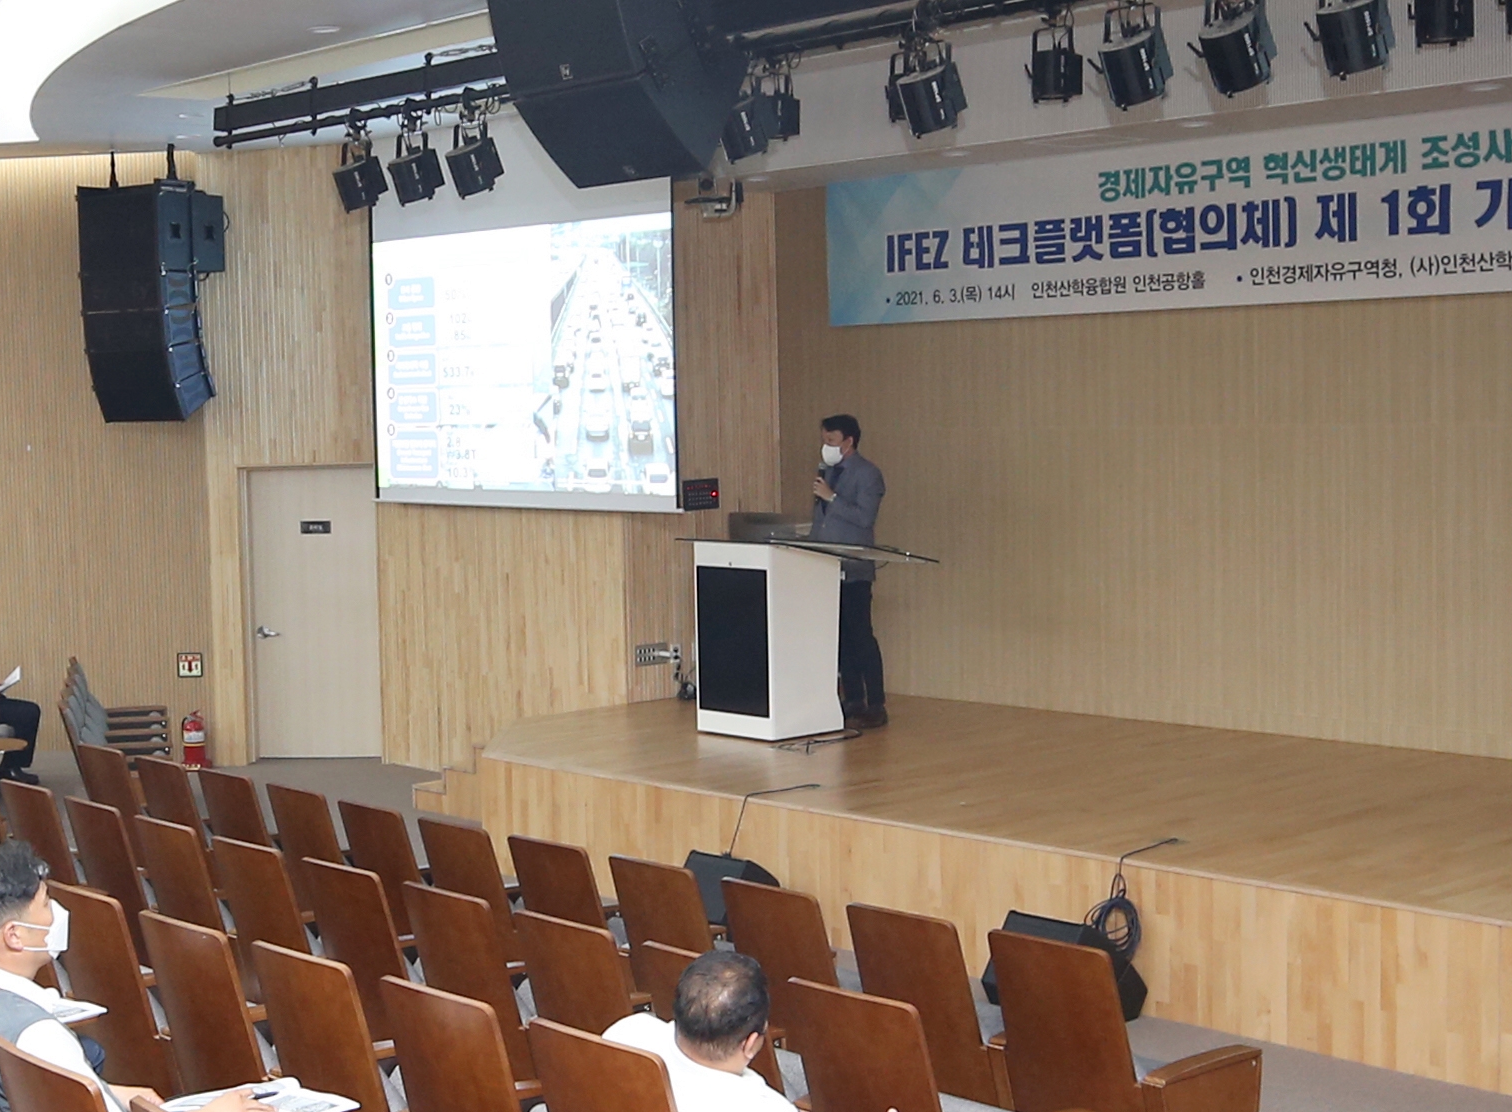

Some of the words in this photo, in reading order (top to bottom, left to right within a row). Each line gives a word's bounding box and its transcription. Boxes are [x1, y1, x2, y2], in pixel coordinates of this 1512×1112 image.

[1098, 155, 1252, 202] 경제자유구역
[1263, 139, 1407, 184] 혁신생태계
[887, 230, 950, 273] IFEZ
[962, 196, 1298, 270] 테크플랫폼(협의체)
[1315, 192, 1358, 243] 제
[1381, 184, 1451, 236] 1회
[896, 291, 930, 307] 2021.
[987, 284, 1016, 302] 14시
[1031, 275, 1127, 300] 인천산학융합원
[1133, 270, 1206, 293] 인천공항홀
[1249, 256, 1403, 287] 인천경제자유구역청,
